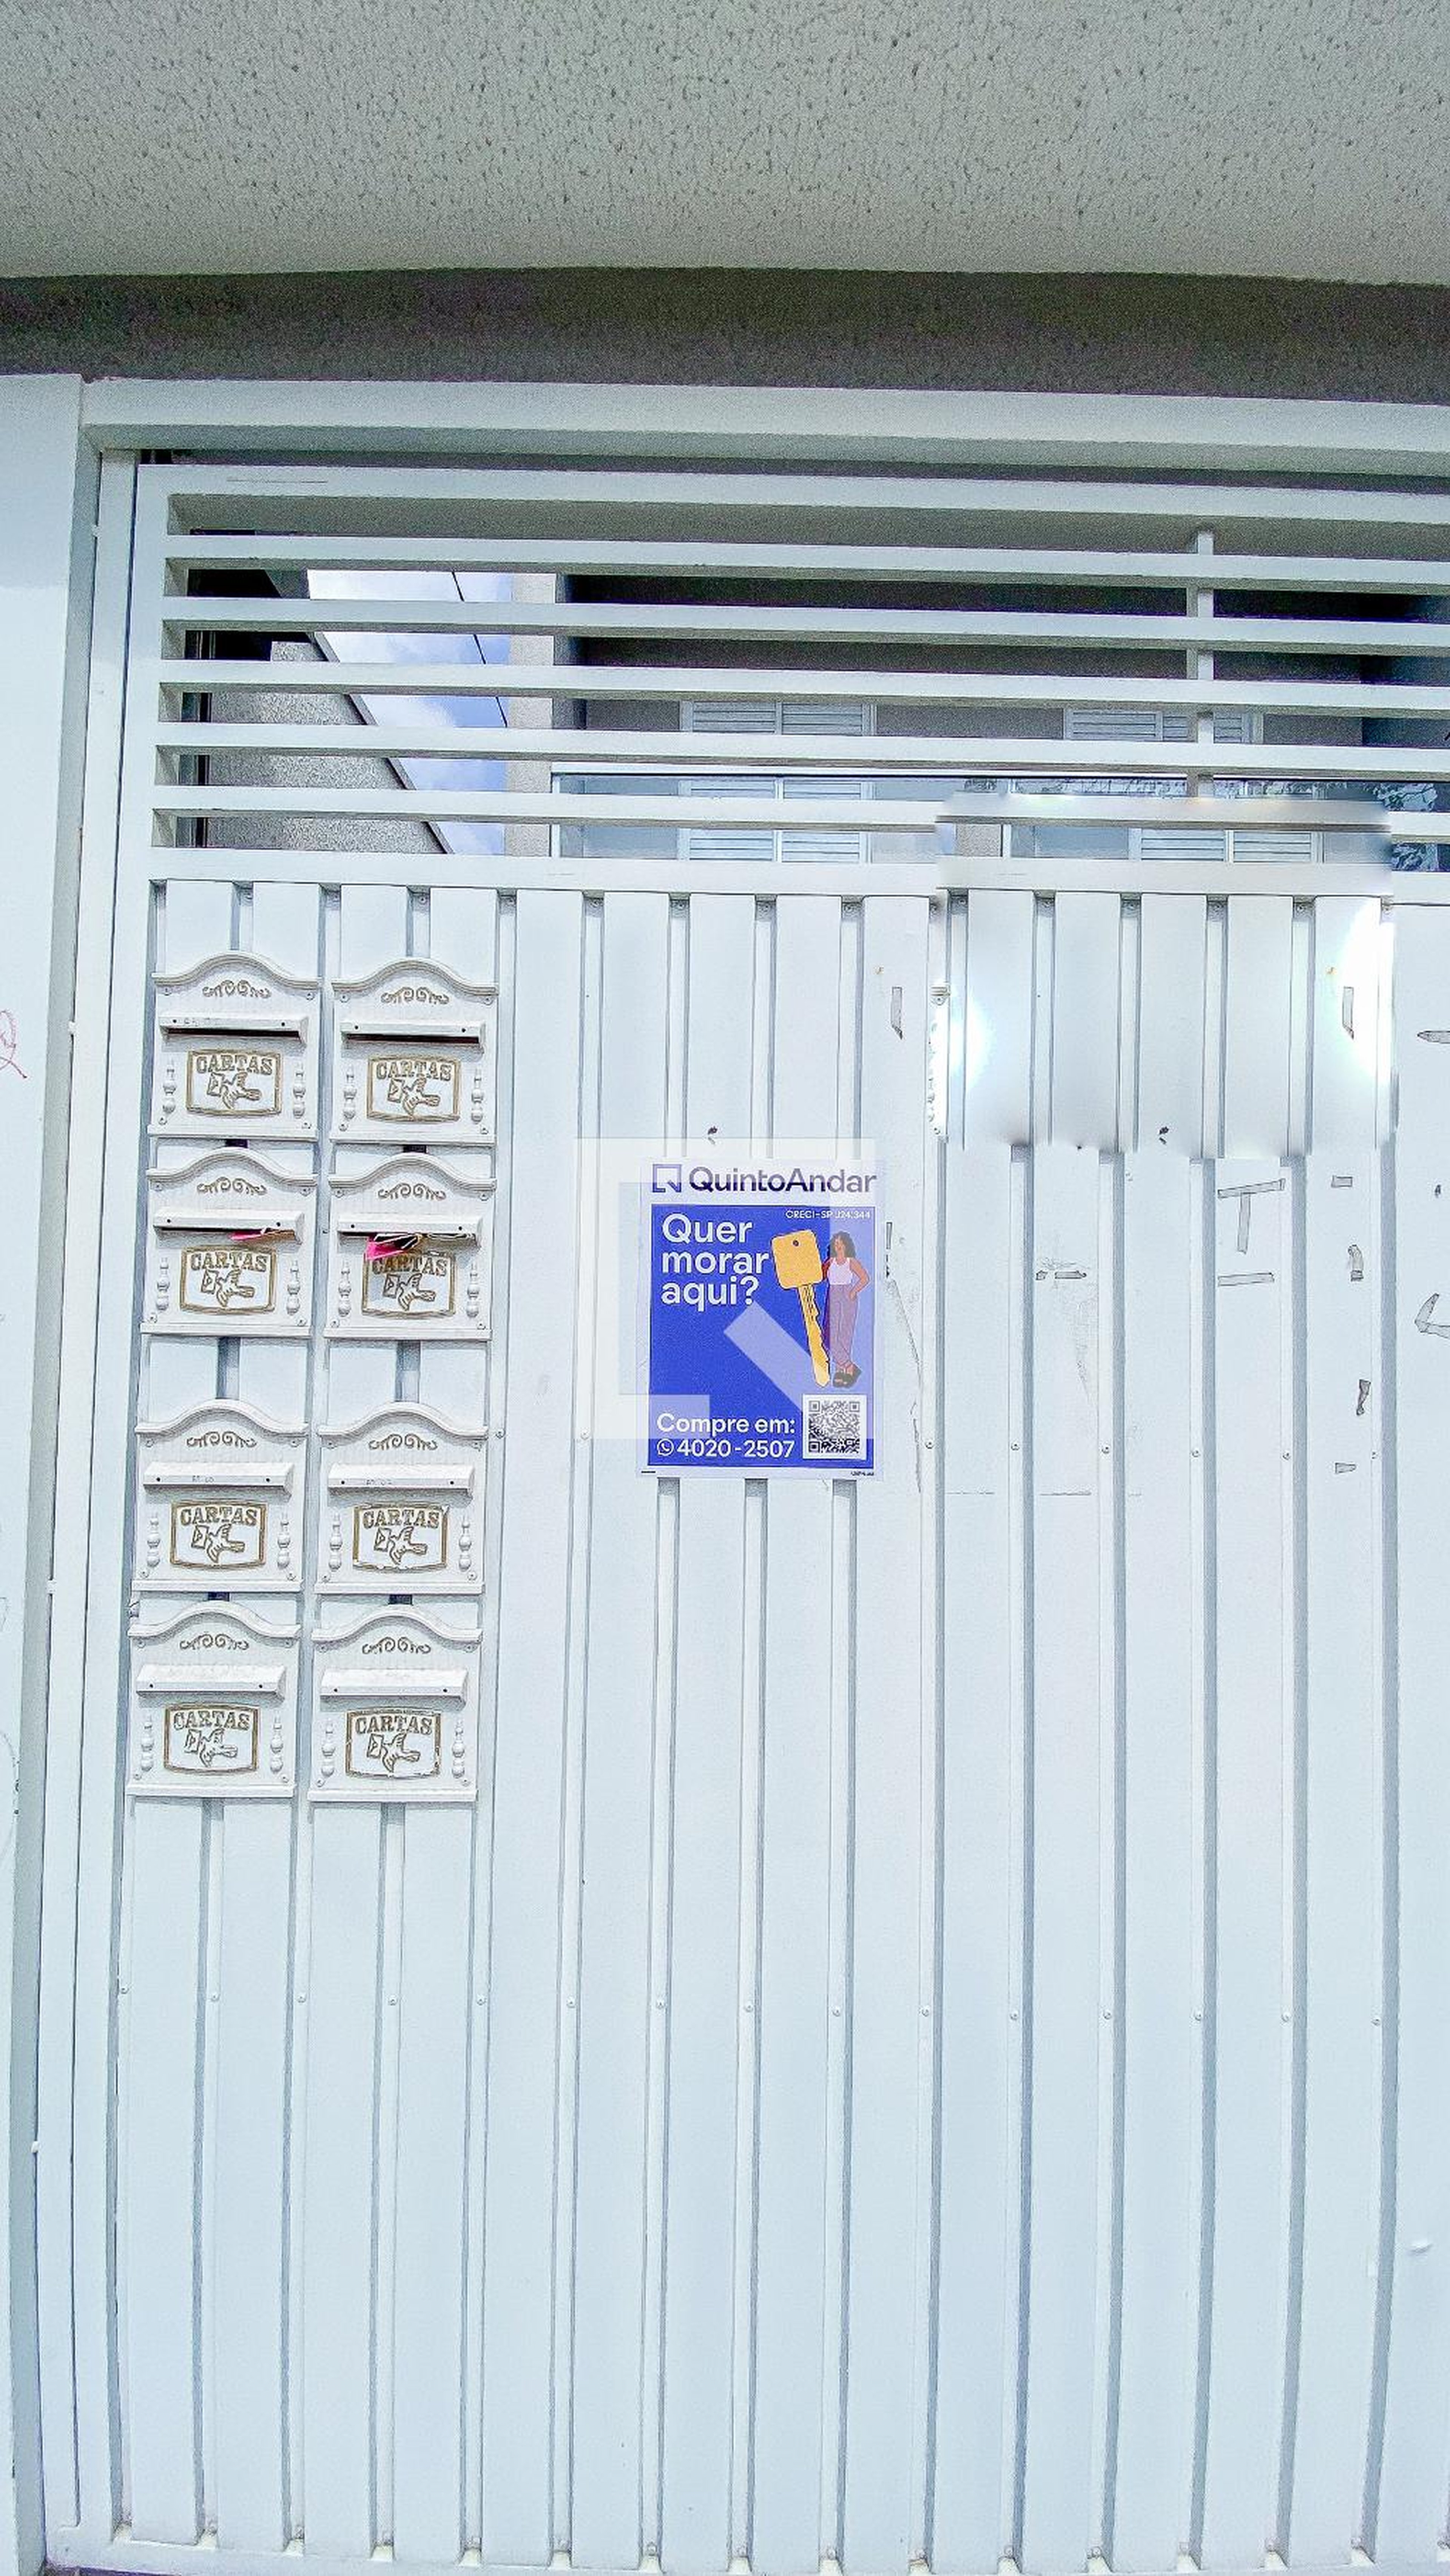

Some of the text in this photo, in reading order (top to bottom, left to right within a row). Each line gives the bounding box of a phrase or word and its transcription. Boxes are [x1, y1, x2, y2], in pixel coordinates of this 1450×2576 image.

[196, 1055, 273, 1075] CARTAS
[376, 1060, 452, 1082] CARTAS
[689, 1166, 877, 1193] QuintoAndar
[662, 1213, 753, 1244] Quer
[190, 1252, 267, 1272] CARTAS
[372, 1255, 447, 1276] CARTAS
[662, 1250, 770, 1275] morar
[661, 1275, 759, 1312] aqui?
[656, 1413, 796, 1436] Compre em:
[180, 1506, 258, 1527] CARTAS
[362, 1509, 439, 1528] CARTAS
[173, 1712, 250, 1730] CARTAS
[355, 1716, 432, 1735] CARTAS
